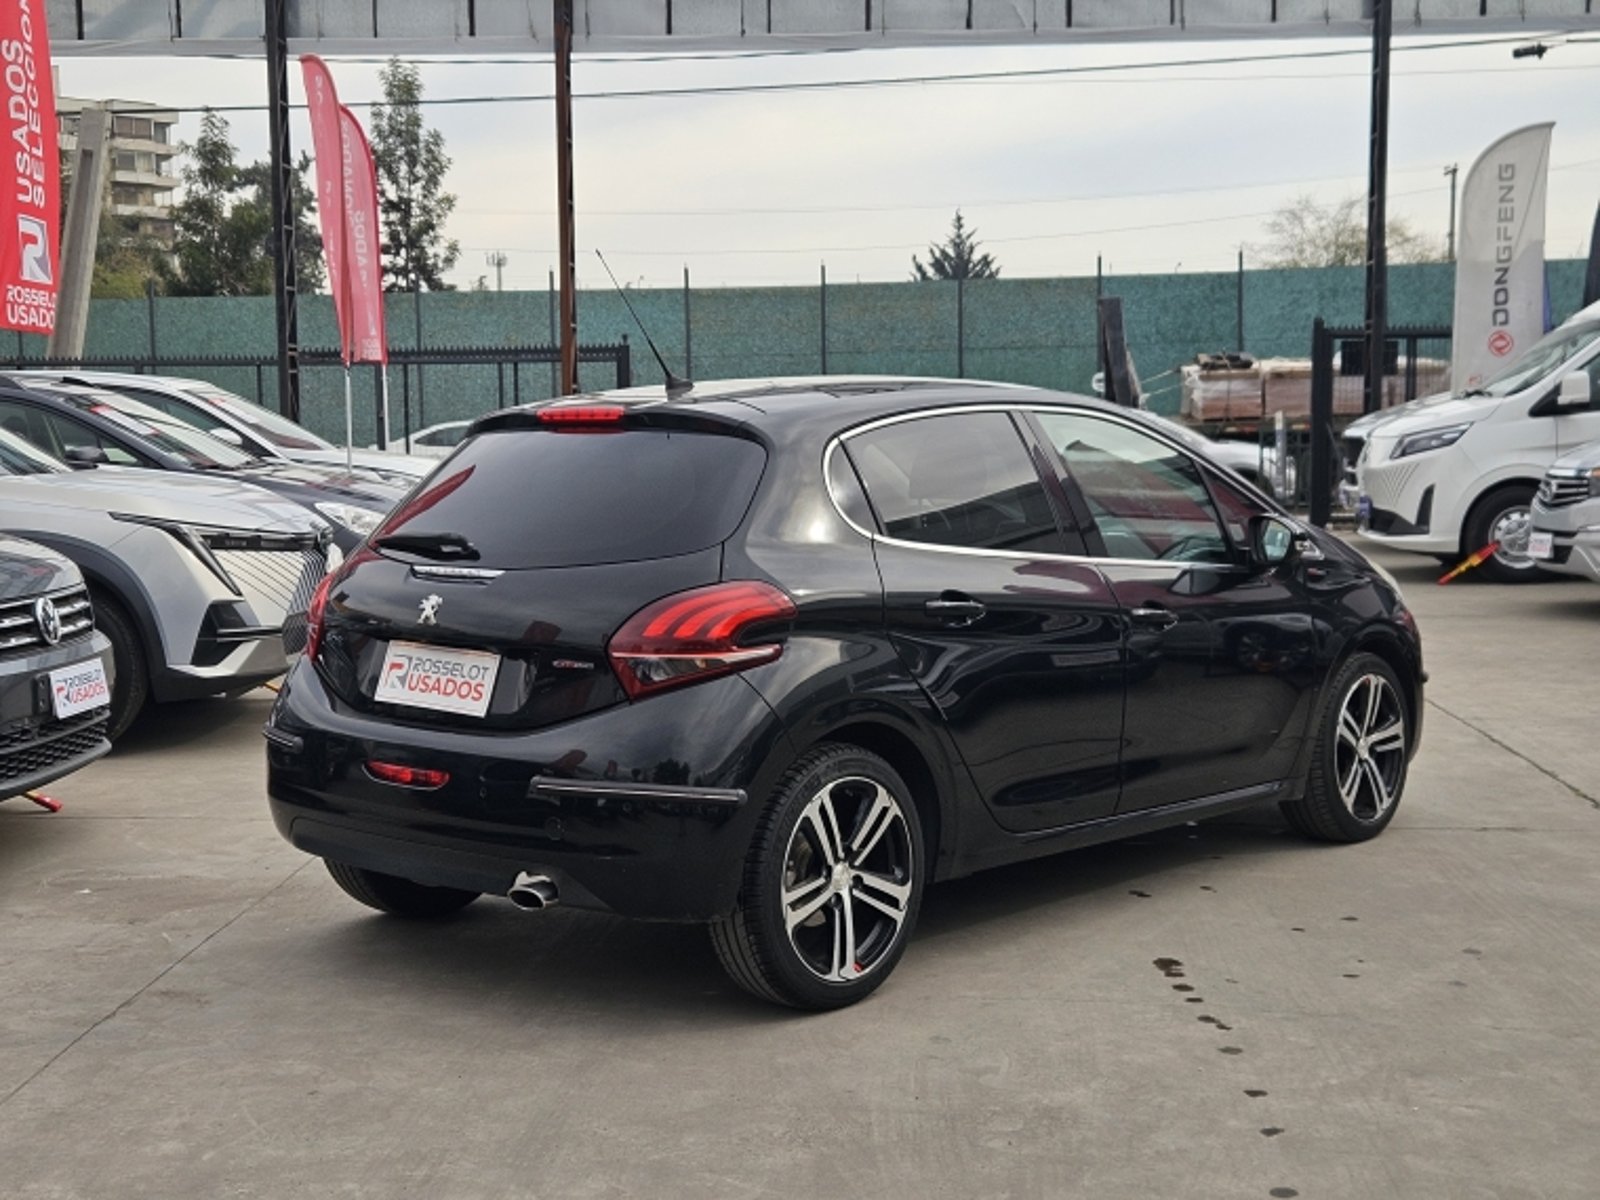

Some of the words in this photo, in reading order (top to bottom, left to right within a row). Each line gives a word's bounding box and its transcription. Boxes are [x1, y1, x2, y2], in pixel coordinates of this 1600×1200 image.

[1, 38, 33, 203] USADOS
[1493, 163, 1515, 327] DONGFENG
[412, 656, 490, 681] ROSSELOT
[71, 682, 106, 704] USADOS
[408, 673, 485, 702] USADOS
